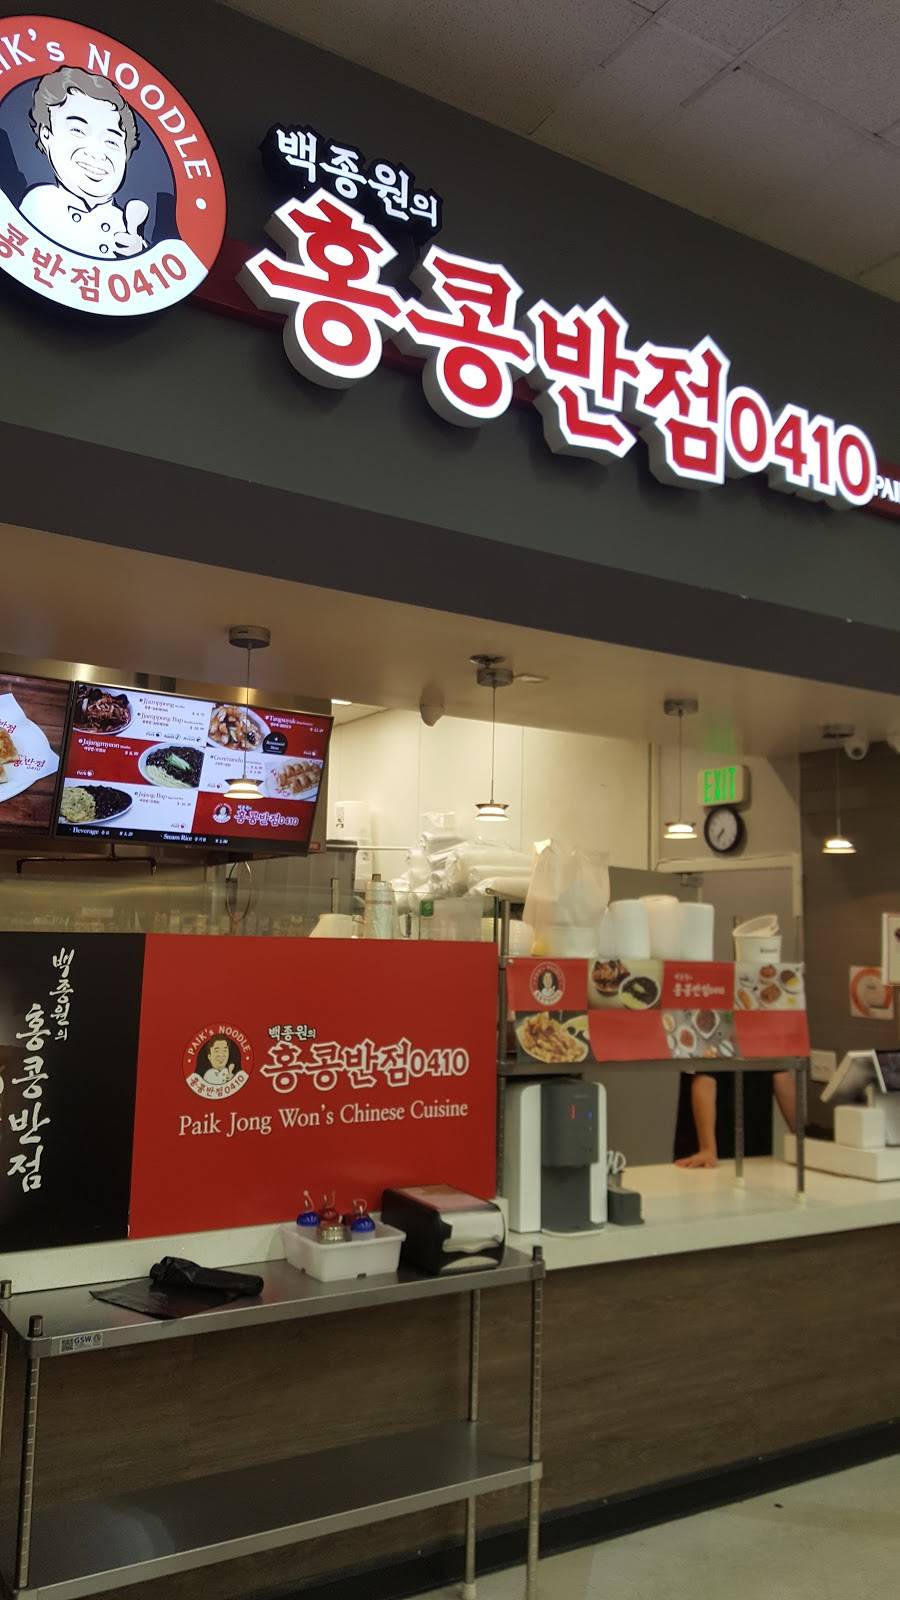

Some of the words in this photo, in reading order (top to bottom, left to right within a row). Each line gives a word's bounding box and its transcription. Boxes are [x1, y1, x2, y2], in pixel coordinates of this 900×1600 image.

[87, 43, 211, 180] NOODLE
[276, 128, 438, 228] 백종원의
[245, 187, 878, 506] 홍콩반점0410
[703, 767, 736, 803] EXIT
[49, 947, 75, 1041] 백종원의
[187, 1028, 215, 1056] PAIK's
[218, 1025, 251, 1053] NOODLE
[260, 1037, 470, 1094] 홍콩반점0410
[267, 1024, 317, 1041] 백종원의
[7, 1003, 51, 1193] 홍콩반점
[178, 1112, 221, 1136] Paik
[226, 1111, 272, 1137] Jong
[278, 1103, 334, 1129] Won's
[339, 1102, 405, 1124] Chinese
[410, 1098, 469, 1119] Cuisine
